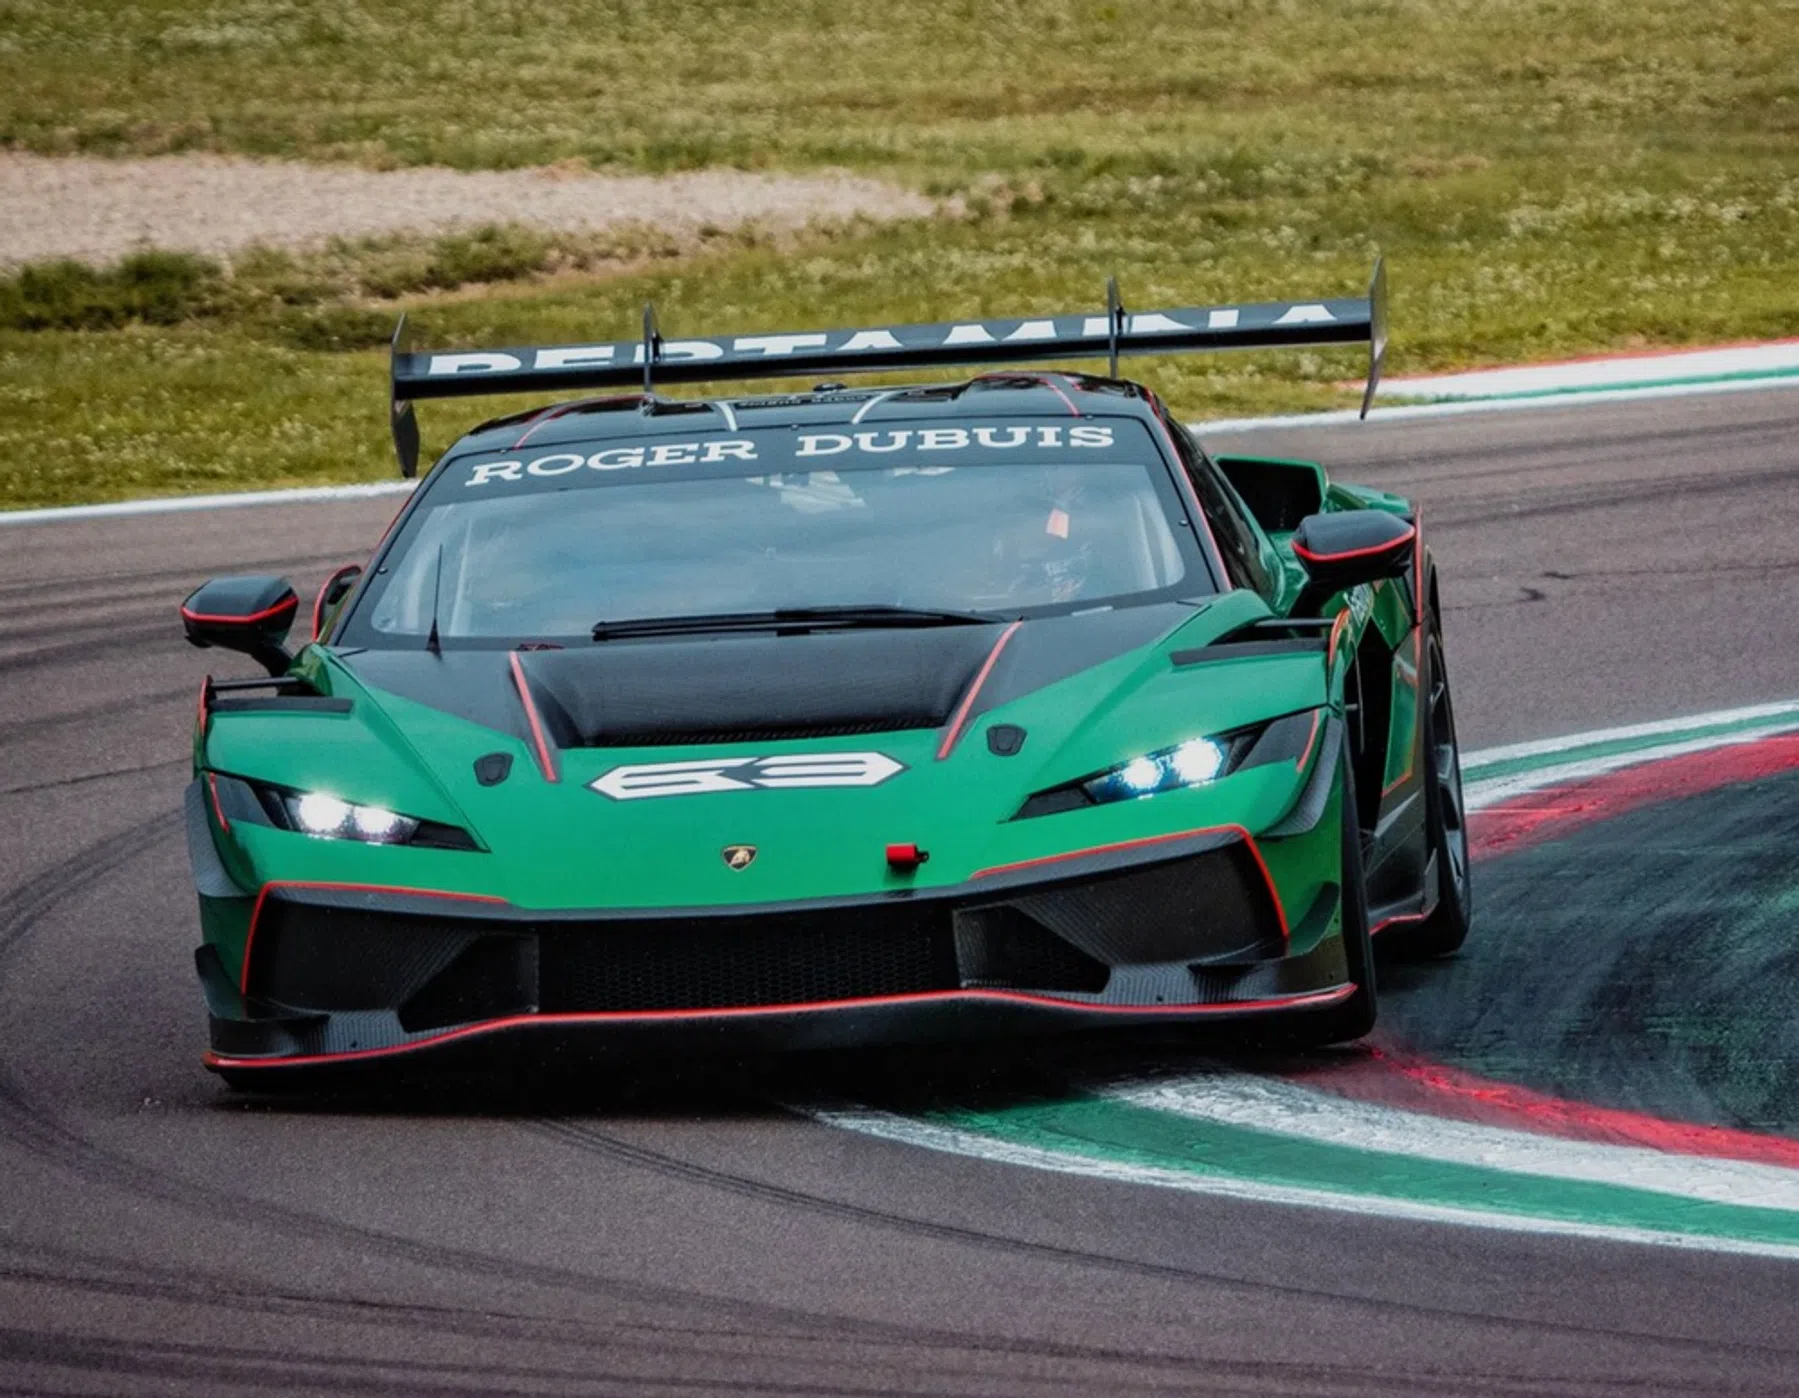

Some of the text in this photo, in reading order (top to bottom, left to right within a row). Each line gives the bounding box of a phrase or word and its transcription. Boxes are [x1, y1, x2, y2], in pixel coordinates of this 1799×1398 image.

[464, 426, 1115, 487] ROGER DUBUIS
[588, 751, 905, 801] 63
